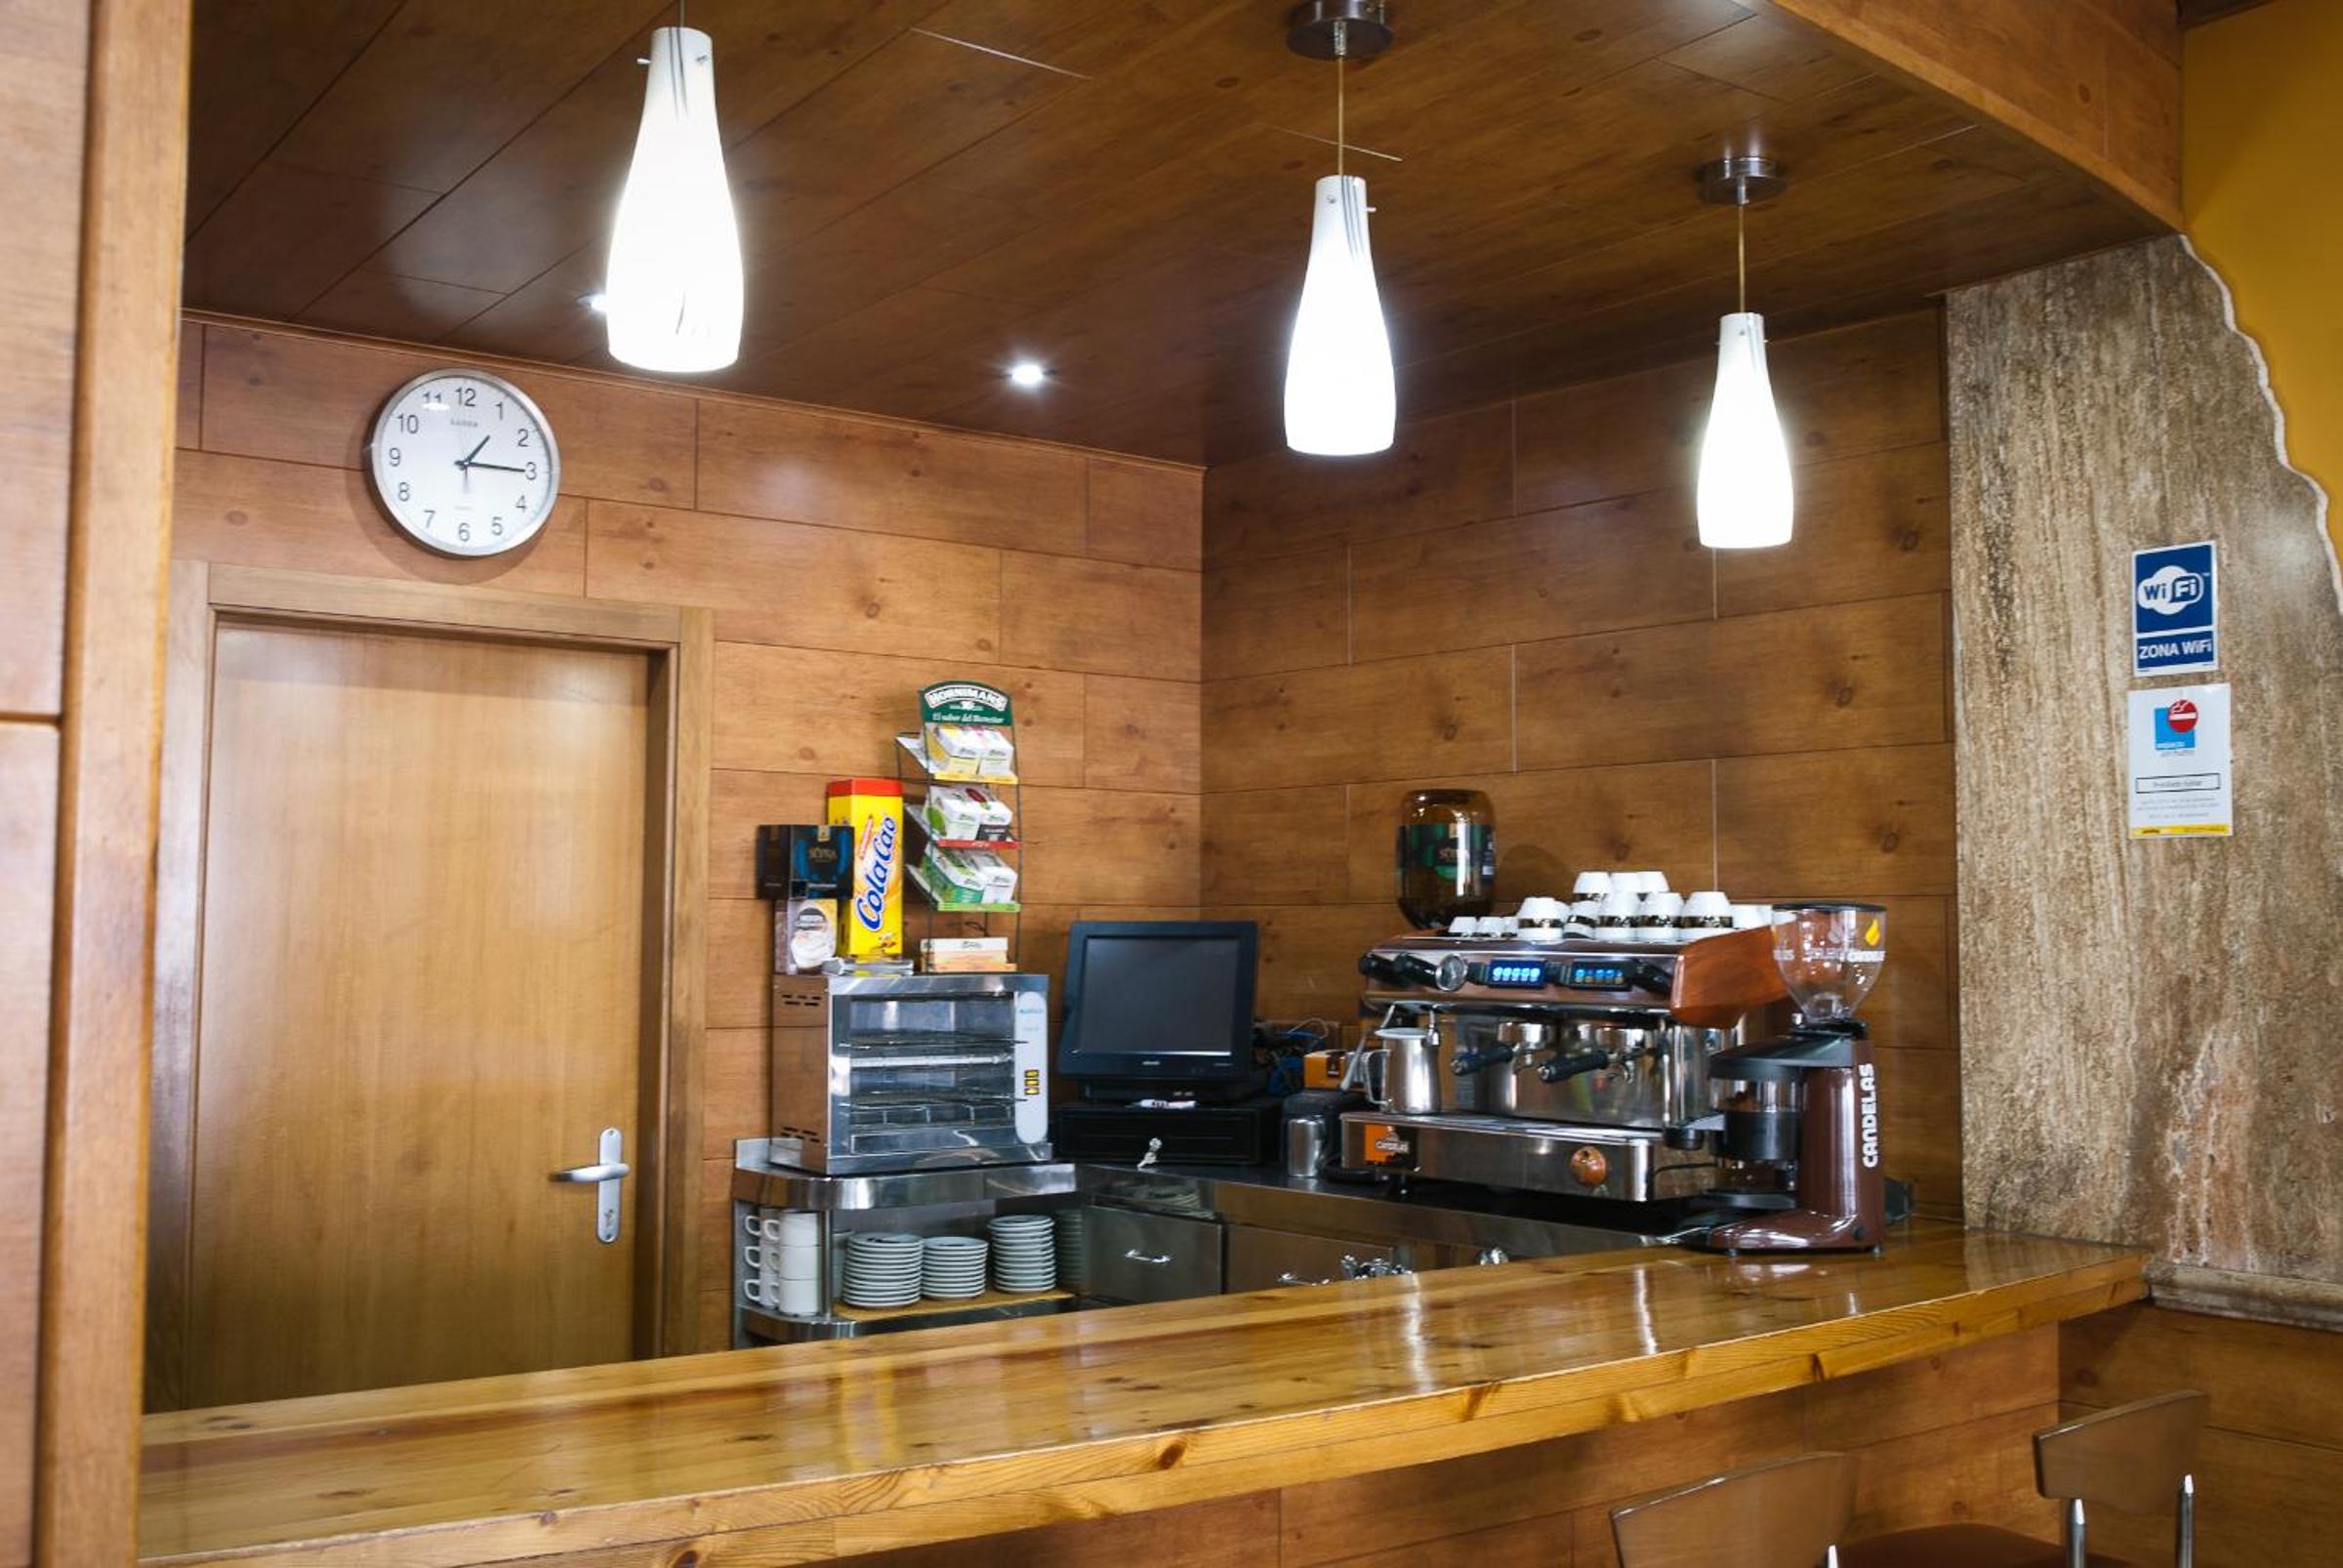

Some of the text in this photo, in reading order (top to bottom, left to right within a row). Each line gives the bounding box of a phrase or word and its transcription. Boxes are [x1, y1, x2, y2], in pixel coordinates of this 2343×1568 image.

[456, 387, 476, 407] 12
[495, 401, 504, 420] 1
[397, 414, 420, 434] 10
[517, 429, 529, 447] 2
[389, 447, 401, 467] 9
[525, 462, 537, 480] 3
[397, 482, 410, 502] 8
[515, 495, 526, 513] 4
[424, 510, 435, 528] 7
[491, 516, 503, 536] 5
[458, 522, 470, 542] 6
[2139, 642, 2180, 660] ZONA
[1858, 1063, 1879, 1168] CANDELAS
